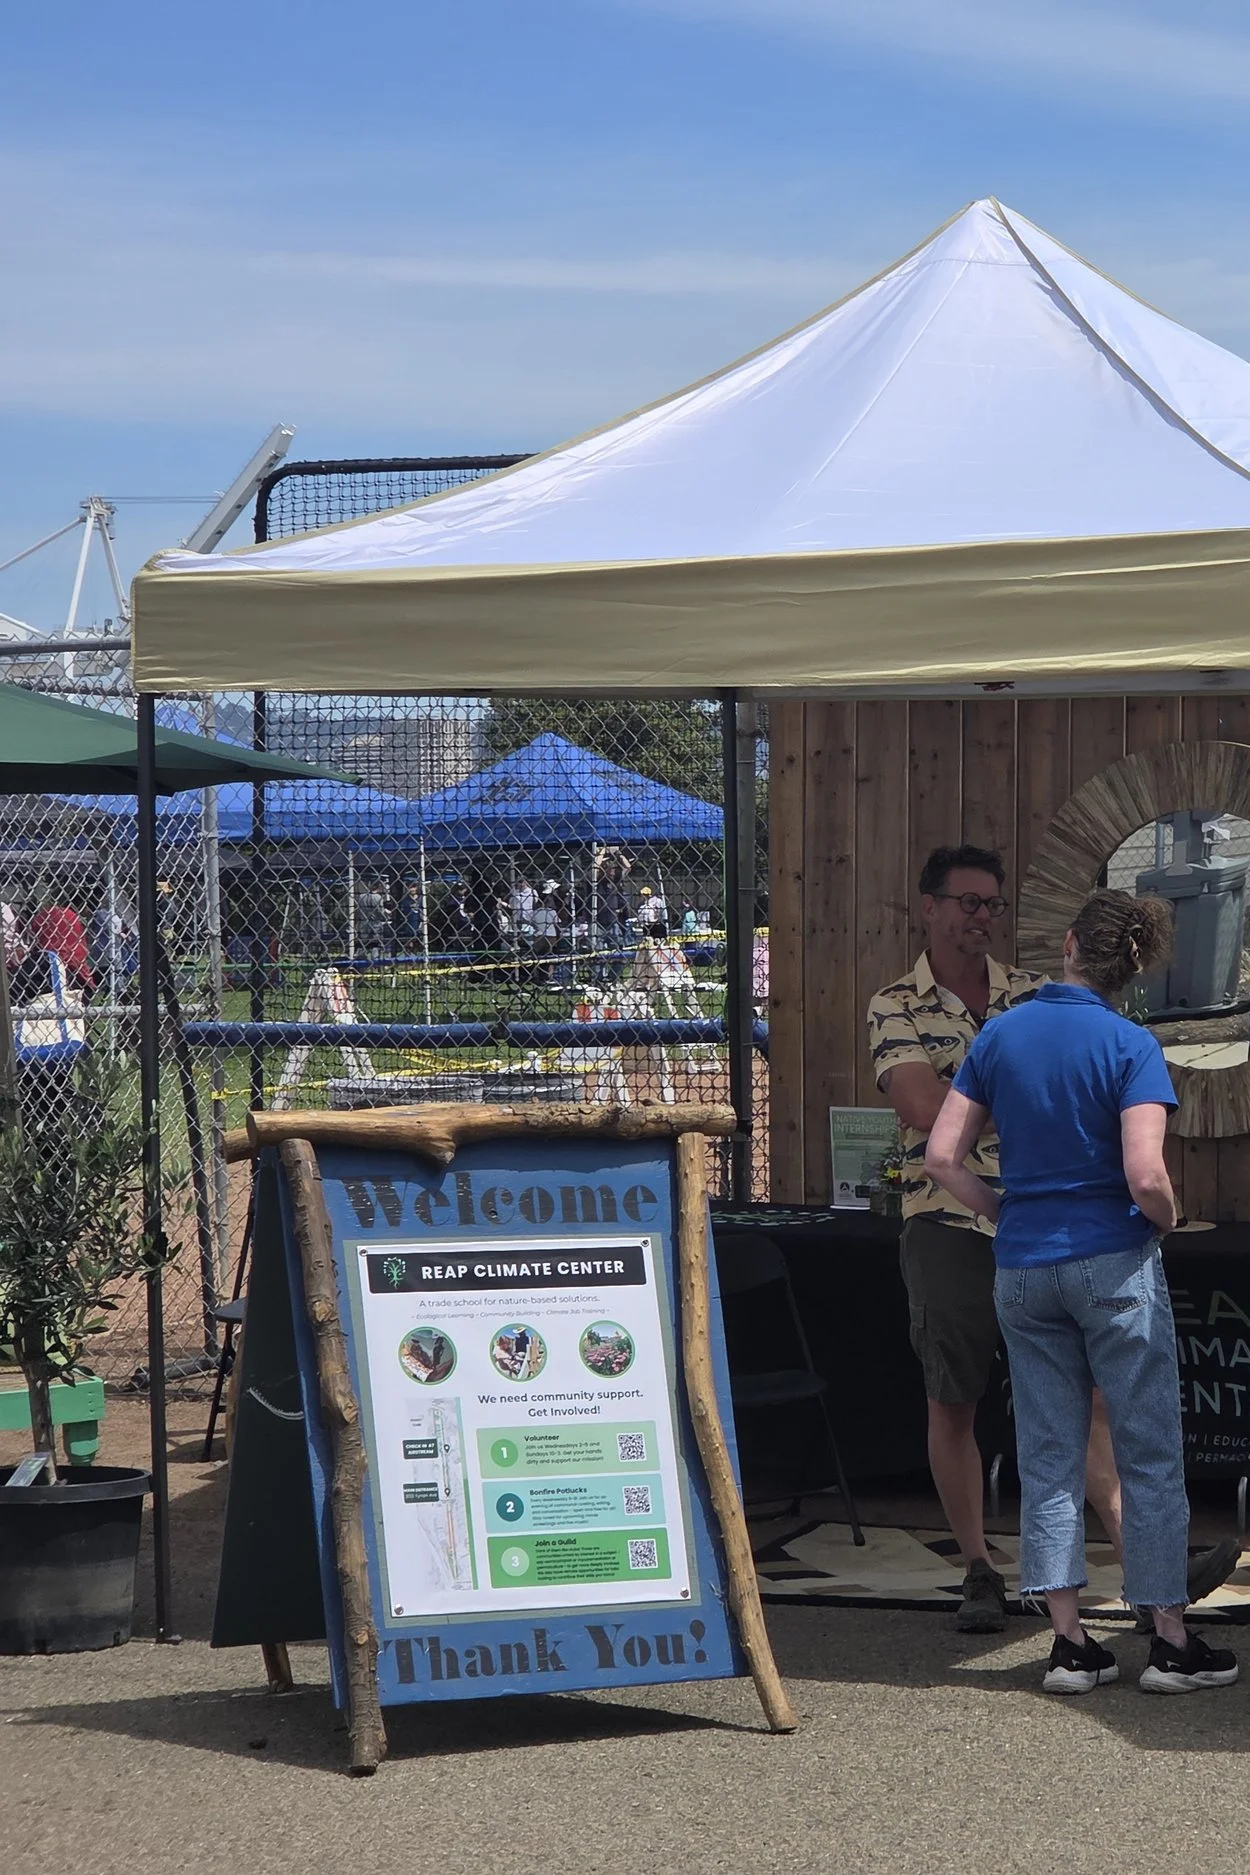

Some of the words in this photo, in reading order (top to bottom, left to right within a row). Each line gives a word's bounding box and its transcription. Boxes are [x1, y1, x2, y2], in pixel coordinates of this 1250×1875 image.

[341, 1171, 658, 1228] Welcome
[421, 1265, 468, 1280] REAP
[474, 1262, 551, 1278] CLIMATE
[557, 1260, 624, 1276] CENTER
[428, 1299, 452, 1307] trade
[454, 1298, 481, 1306] school
[499, 1296, 557, 1305] nature-based
[477, 1395, 497, 1404] We
[500, 1393, 528, 1403] need
[531, 1390, 594, 1402] community
[597, 1389, 644, 1400] support.
[528, 1408, 548, 1417] Get
[551, 1405, 601, 1416] Involved!
[500, 1447, 508, 1459] 1
[556, 1487, 588, 1495] Potlucks
[505, 1501, 515, 1513] 2
[535, 1539, 550, 1547] Join
[557, 1538, 577, 1546] Guild
[512, 1555, 519, 1567] 3
[382, 1628, 568, 1684] Thank
[584, 1619, 706, 1669] You!
